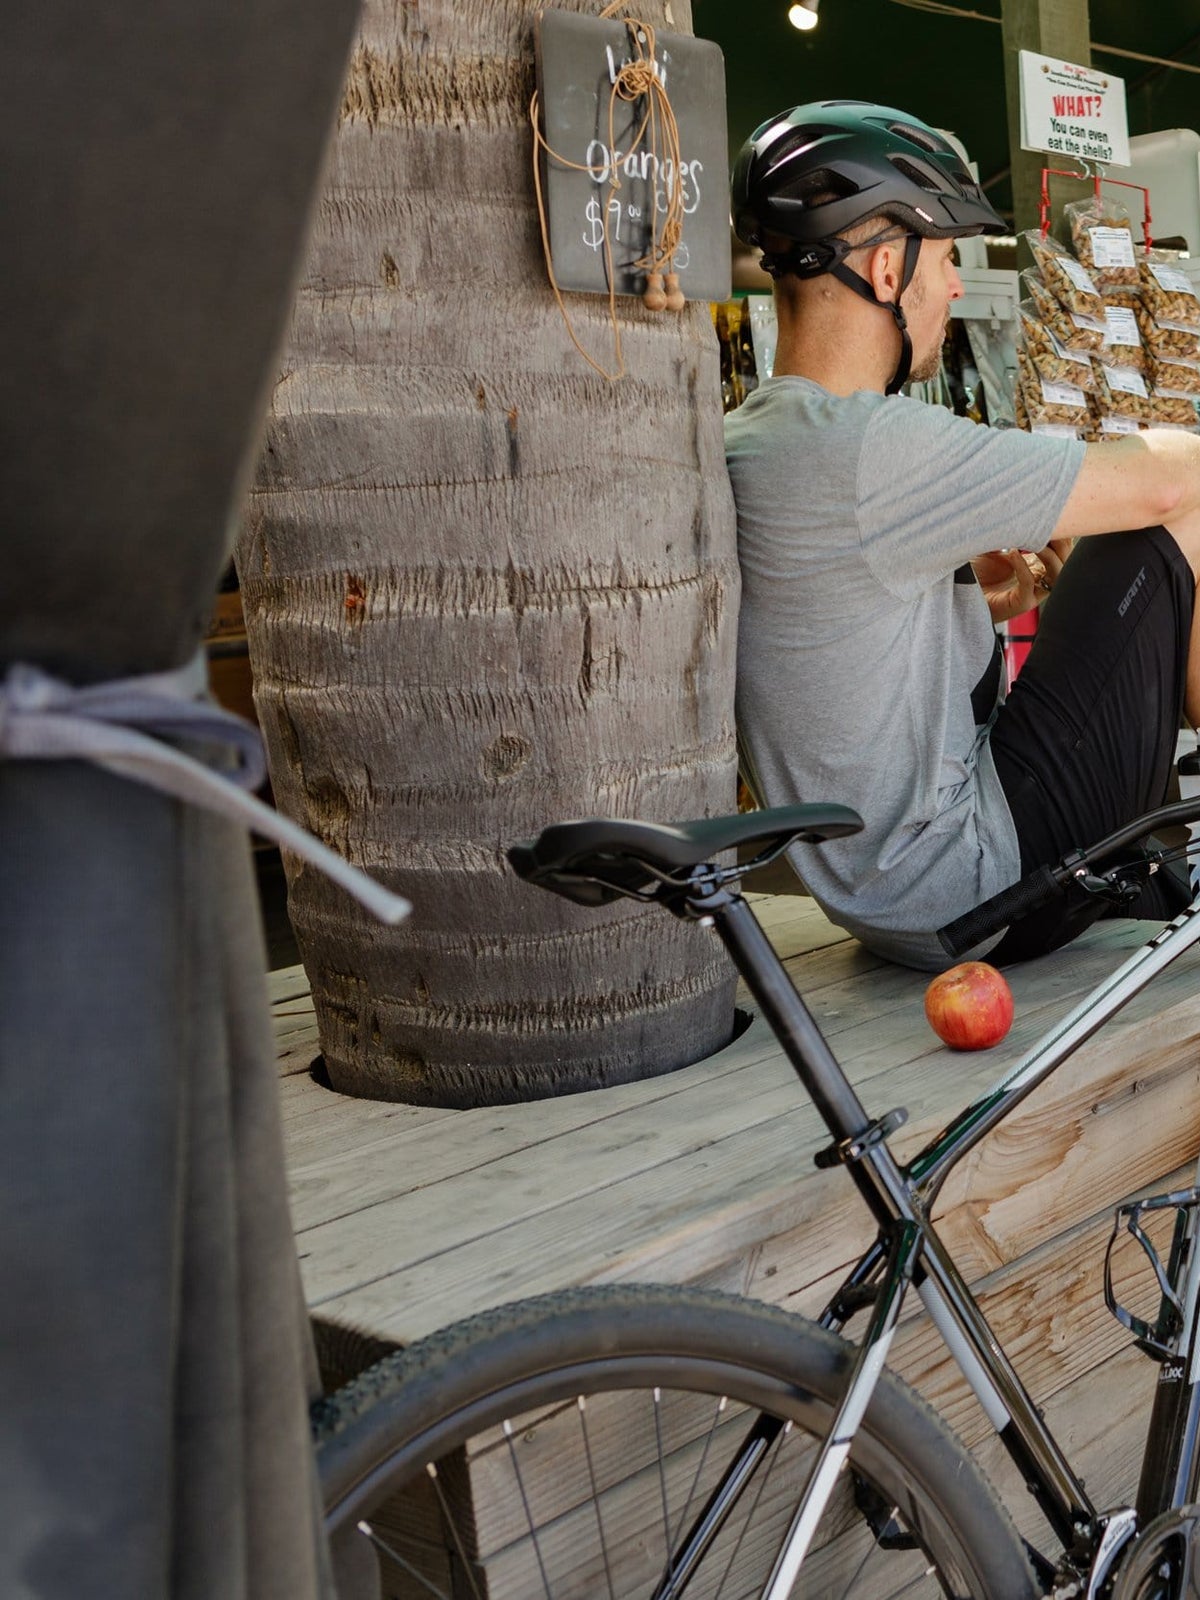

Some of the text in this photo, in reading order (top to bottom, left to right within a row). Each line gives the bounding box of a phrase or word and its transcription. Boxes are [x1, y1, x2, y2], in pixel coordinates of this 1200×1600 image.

[1052, 95, 1102, 117] WHAT?
[1049, 117, 1108, 143] You can even
[1048, 137, 1112, 160] eat the shells?
[1117, 566, 1146, 618] GIANT
